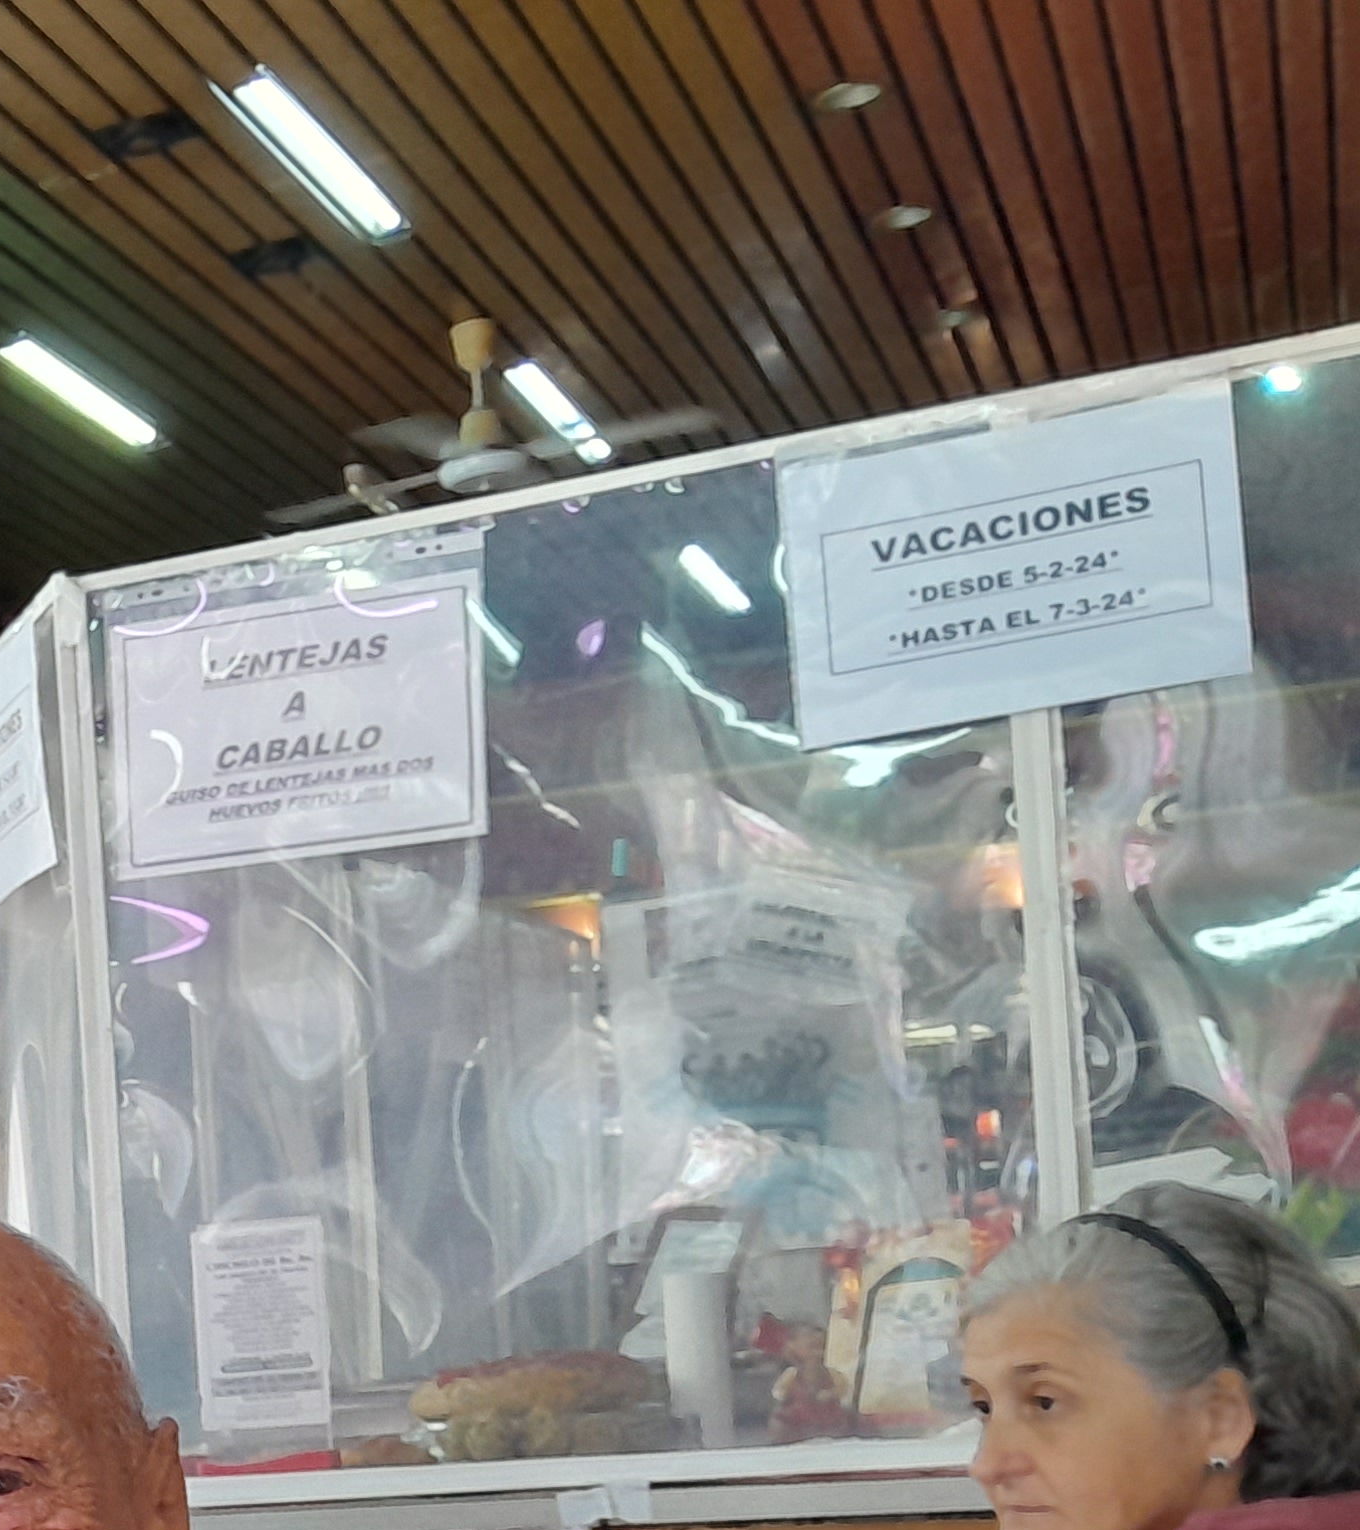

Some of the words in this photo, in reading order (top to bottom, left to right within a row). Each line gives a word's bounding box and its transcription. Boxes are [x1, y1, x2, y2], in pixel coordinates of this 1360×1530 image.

[871, 486, 1151, 563] VACACIONES
[1006, 609, 1040, 629] EL
[282, 690, 305, 716] A
[216, 725, 383, 770] CABALLO
